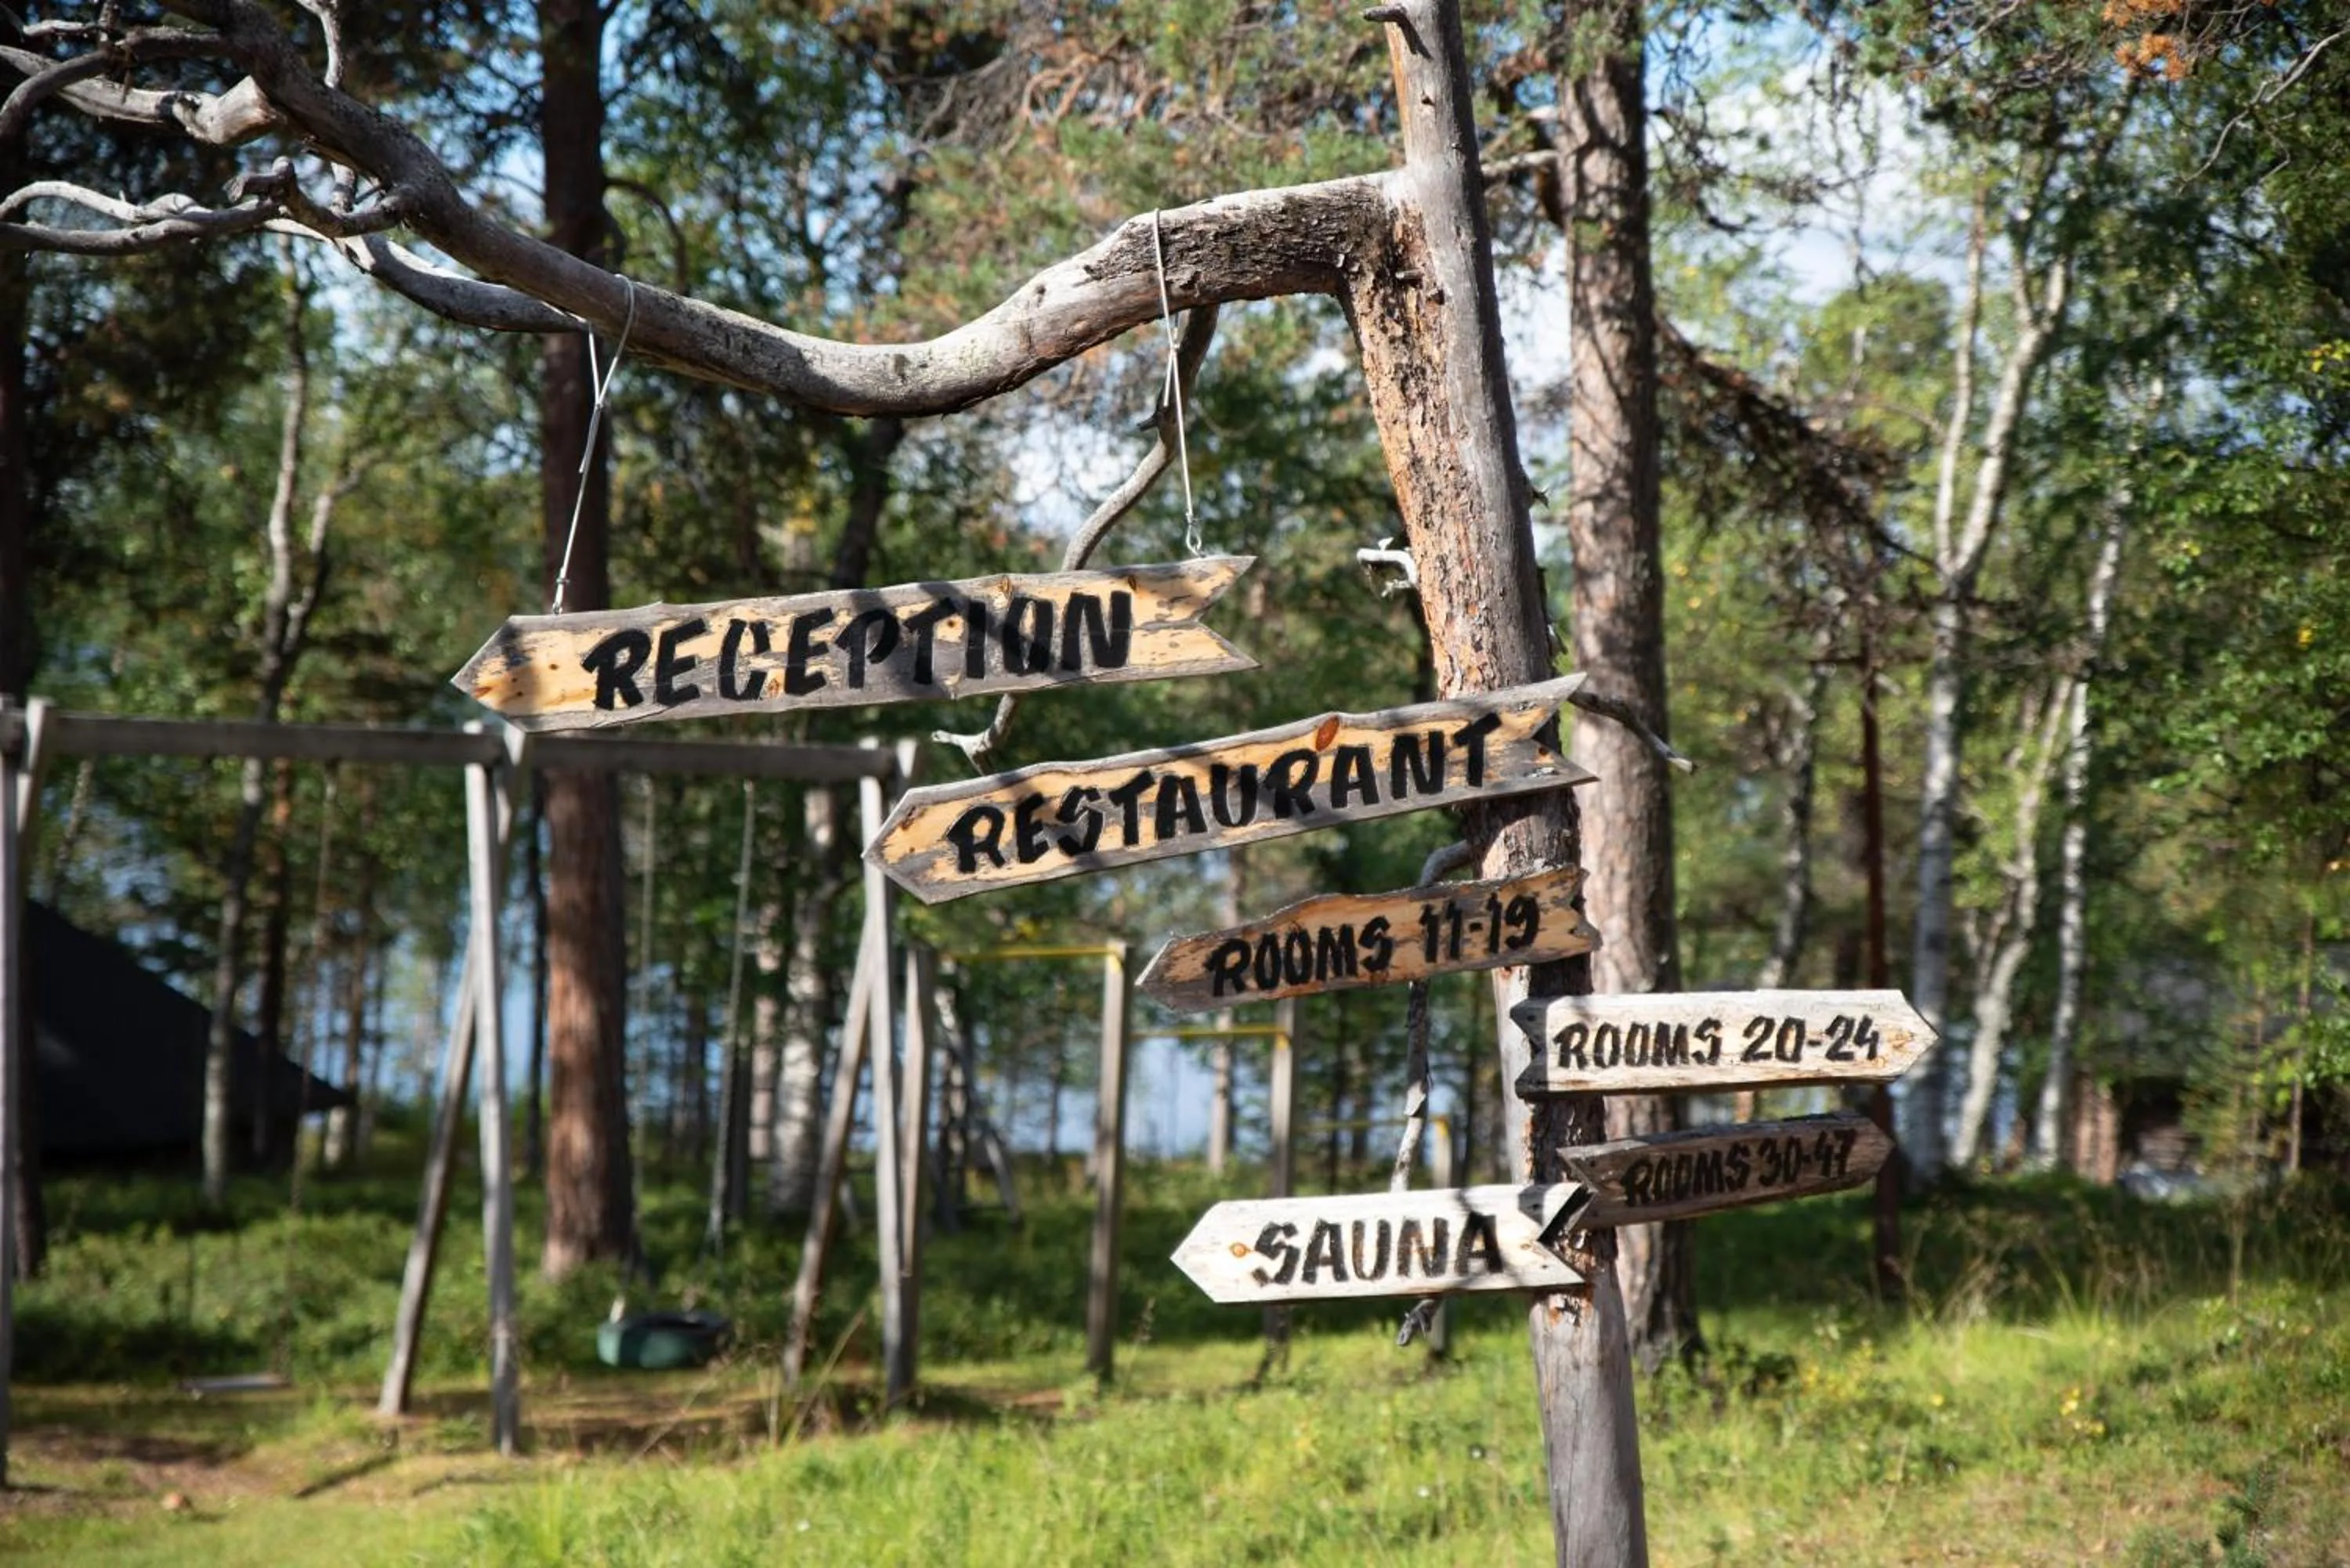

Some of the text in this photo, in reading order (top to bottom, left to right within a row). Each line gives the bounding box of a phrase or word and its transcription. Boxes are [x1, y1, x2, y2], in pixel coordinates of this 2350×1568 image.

[582, 590, 1133, 711] RECEPTION
[946, 712, 1501, 873] RESTAURANT
[1205, 893, 1540, 997] ROOMS 11-19
[1553, 1014, 1880, 1070] ROOMS 20-24
[1620, 1128, 1859, 1208] ROOMS 30-47
[1253, 1210, 1505, 1287] SAUNA
